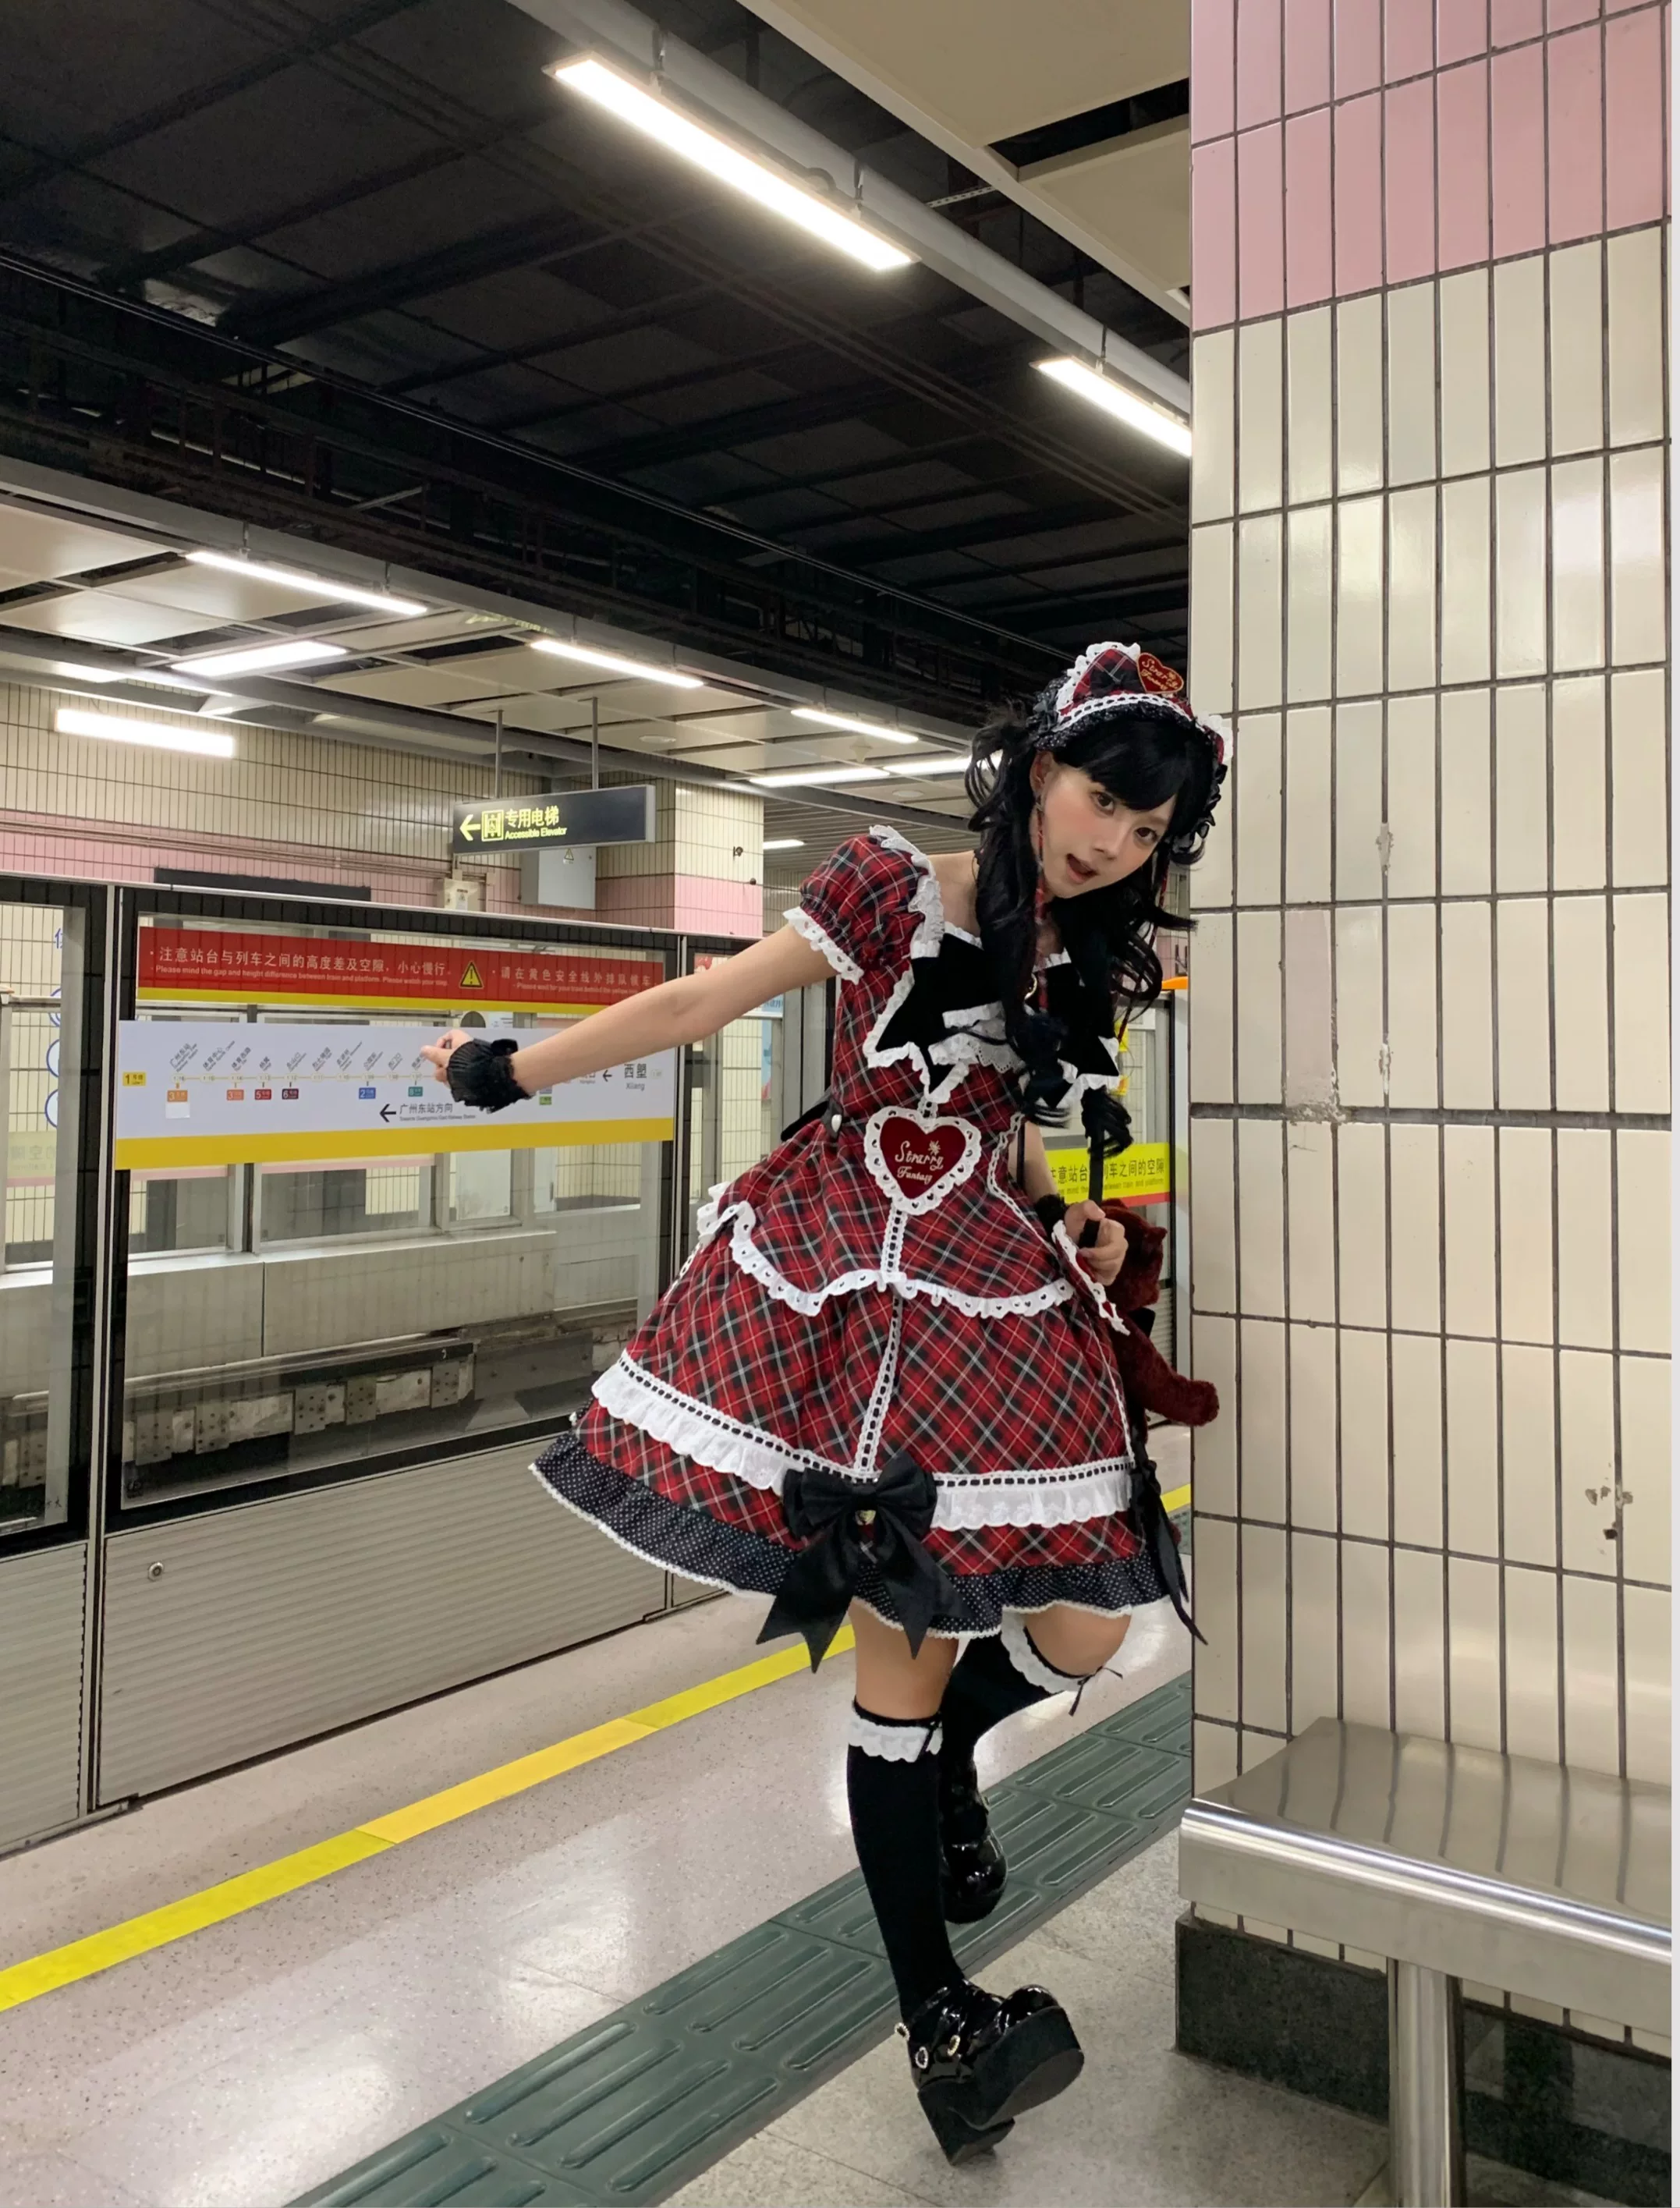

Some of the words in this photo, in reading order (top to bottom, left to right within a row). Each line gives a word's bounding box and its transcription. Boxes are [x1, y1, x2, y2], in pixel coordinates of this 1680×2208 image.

[505, 805, 559, 828] 专用电梯
[505, 828, 540, 840] Accessible
[541, 827, 567, 837] Elevator
[156, 965, 181, 973] Please
[399, 1102, 453, 1115] 广州东站方向
[897, 1166, 933, 1186] Fantasy
